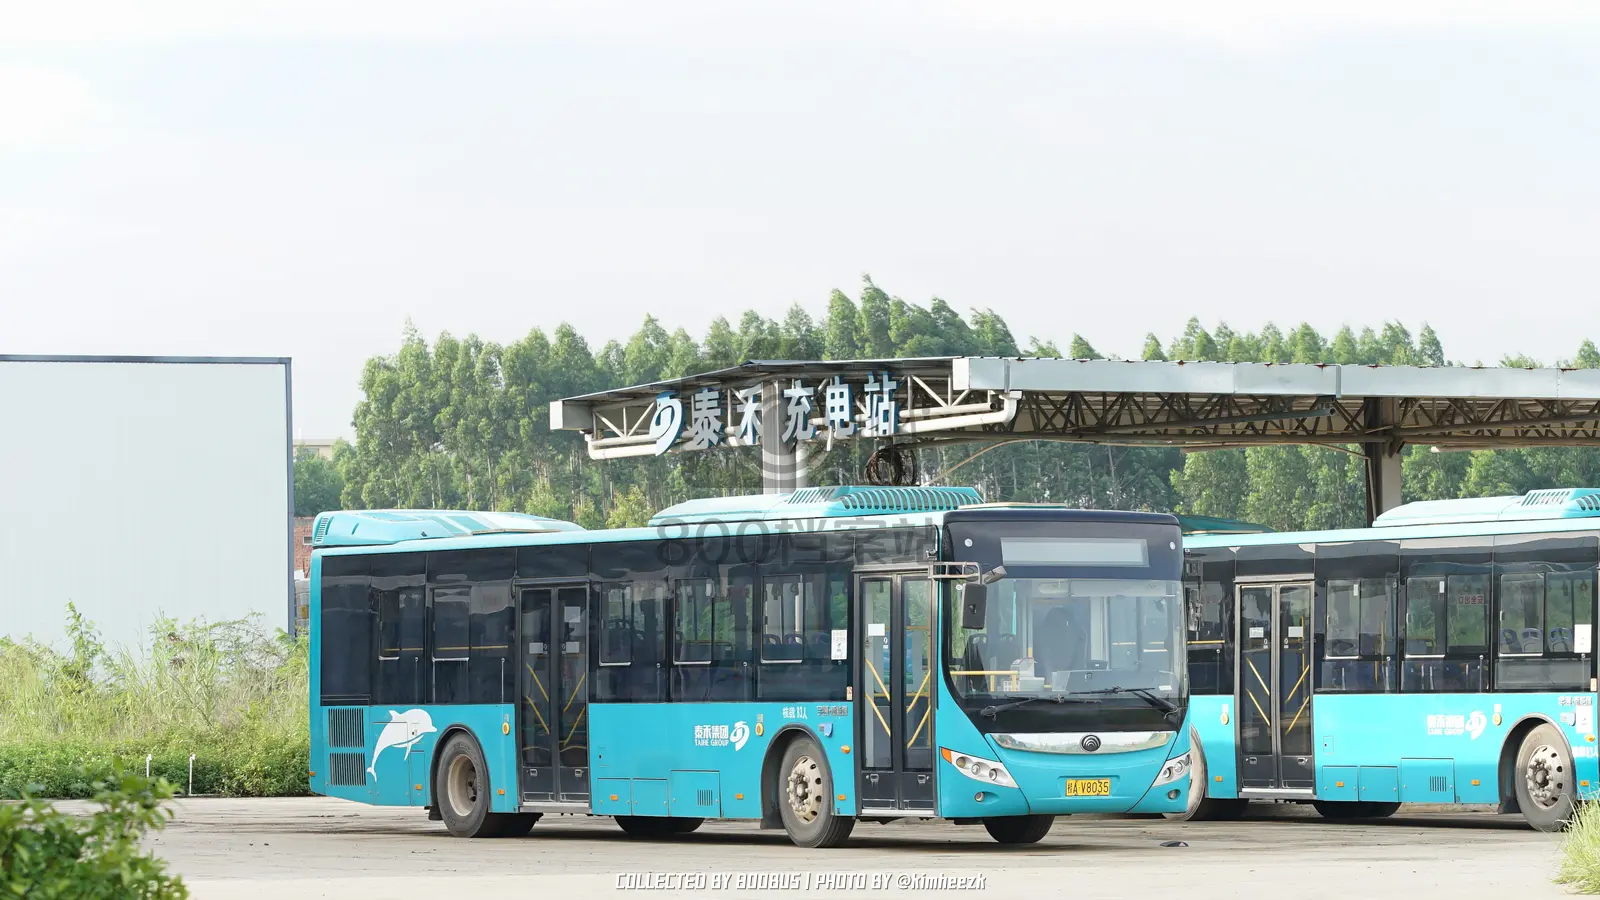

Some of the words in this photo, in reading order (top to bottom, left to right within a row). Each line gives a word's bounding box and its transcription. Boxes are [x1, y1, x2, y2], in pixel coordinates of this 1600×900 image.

[692, 371, 900, 450] 泰禾充电站
[694, 724, 729, 739] 泰禾集团
